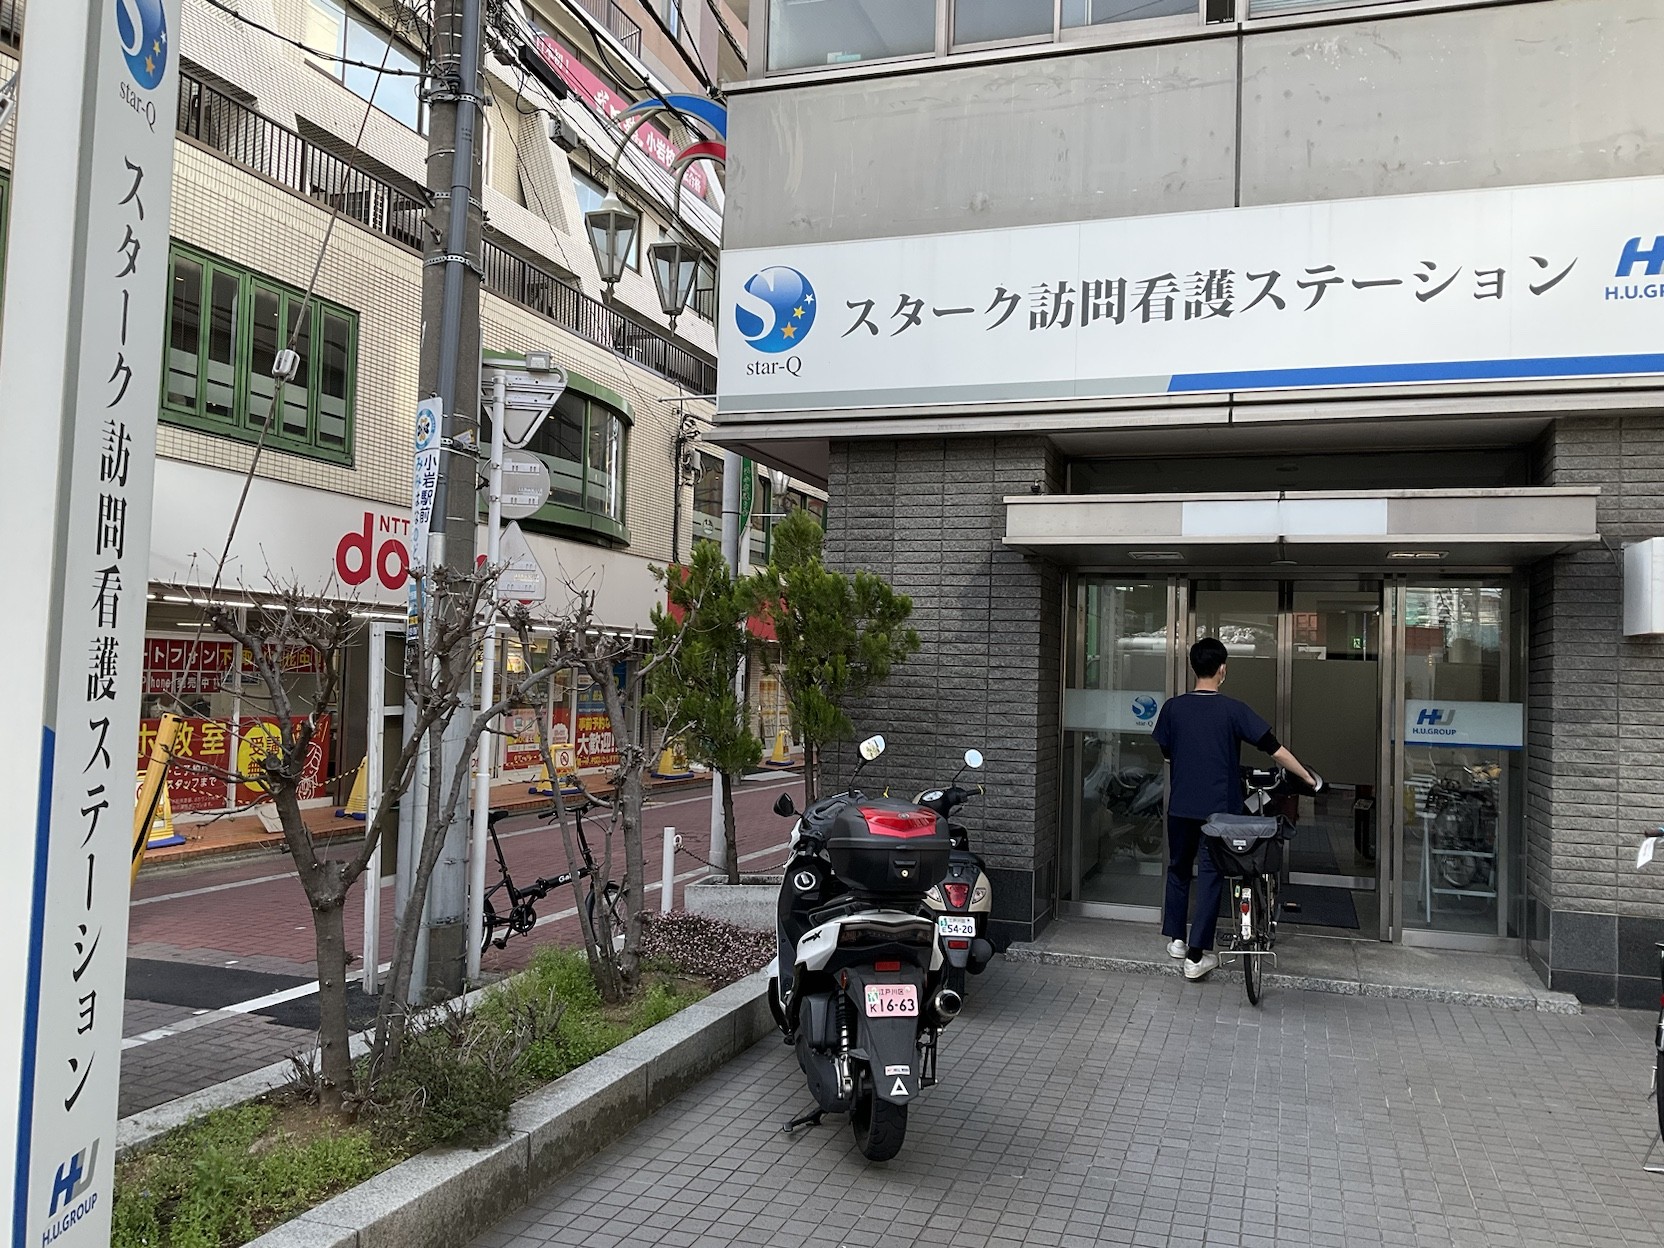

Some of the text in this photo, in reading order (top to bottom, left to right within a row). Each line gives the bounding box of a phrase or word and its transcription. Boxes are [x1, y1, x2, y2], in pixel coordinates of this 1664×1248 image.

[119, 81, 156, 134] star-Q
[841, 255, 1579, 339] スターク訪問看護ステーション
[746, 355, 803, 378] star-Q
[419, 454, 437, 523] 小岩駅前
[379, 515, 411, 536] NTT
[64, 155, 144, 1112] スターク訪問看護ステーション
[577, 731, 618, 755] 大歓迎!
[1412, 727, 1457, 736] H.U.GROUP
[947, 924, 973, 934] 54-20
[870, 998, 915, 1013] K 16-63
[42, 1192, 98, 1248] H.U.GROUP
